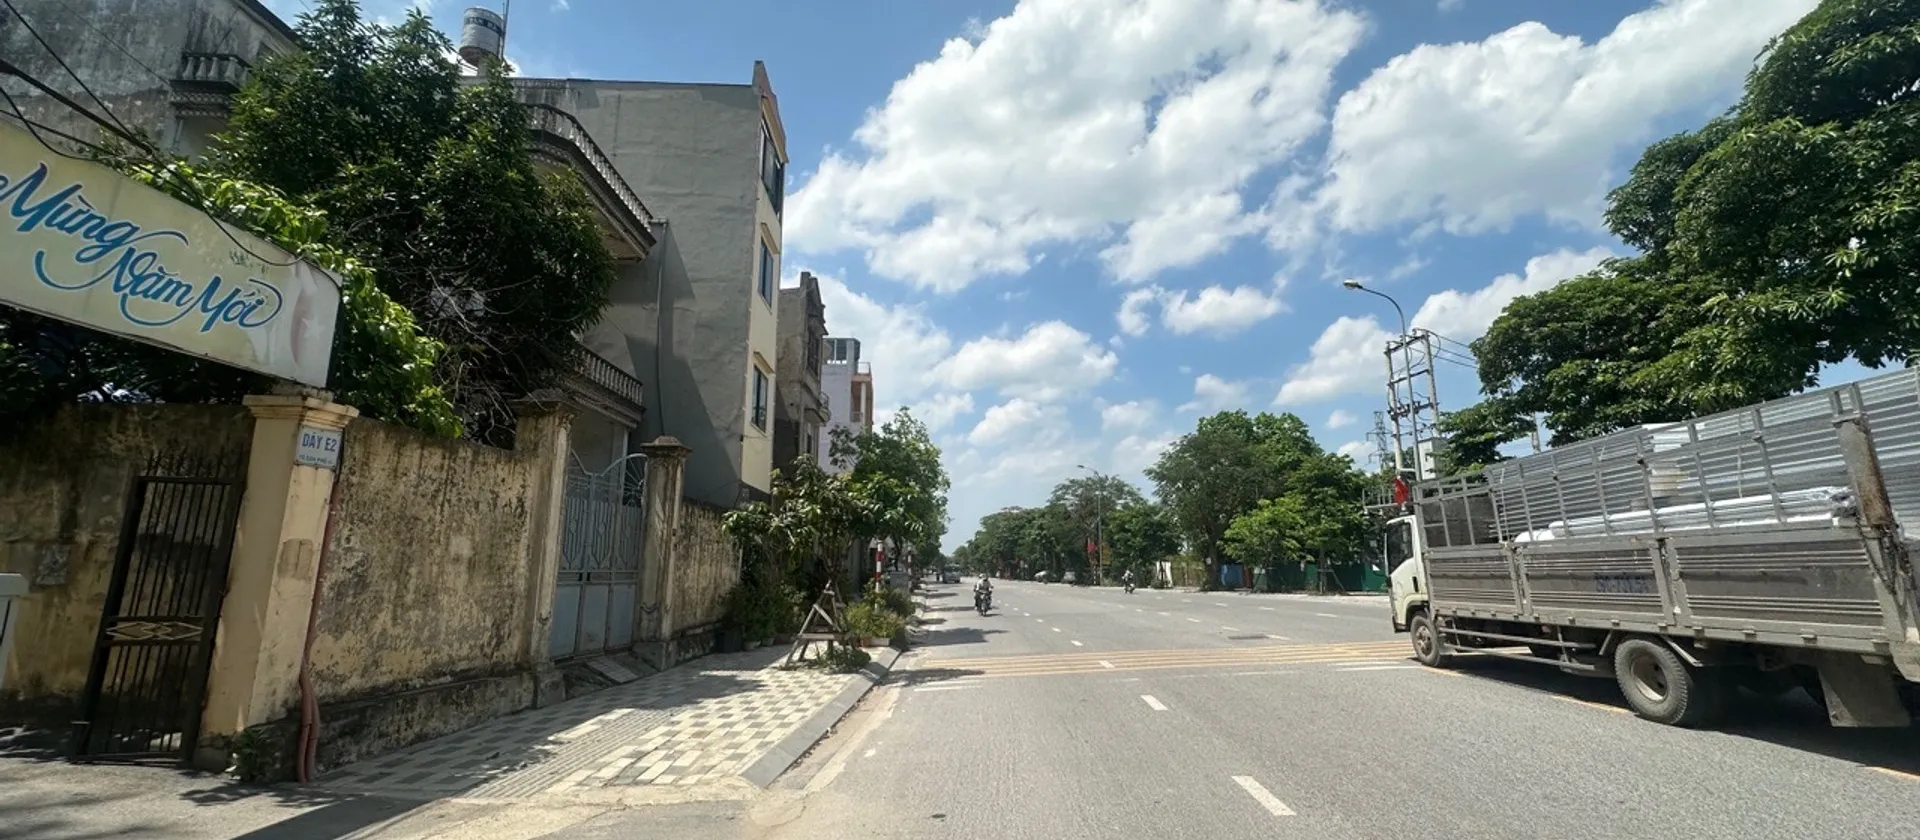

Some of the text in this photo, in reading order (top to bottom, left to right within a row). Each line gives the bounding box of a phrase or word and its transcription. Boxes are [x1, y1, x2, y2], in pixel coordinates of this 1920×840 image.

[2, 162, 142, 263] Mừng
[194, 276, 282, 332] Mới
[324, 437, 337, 452] E2
